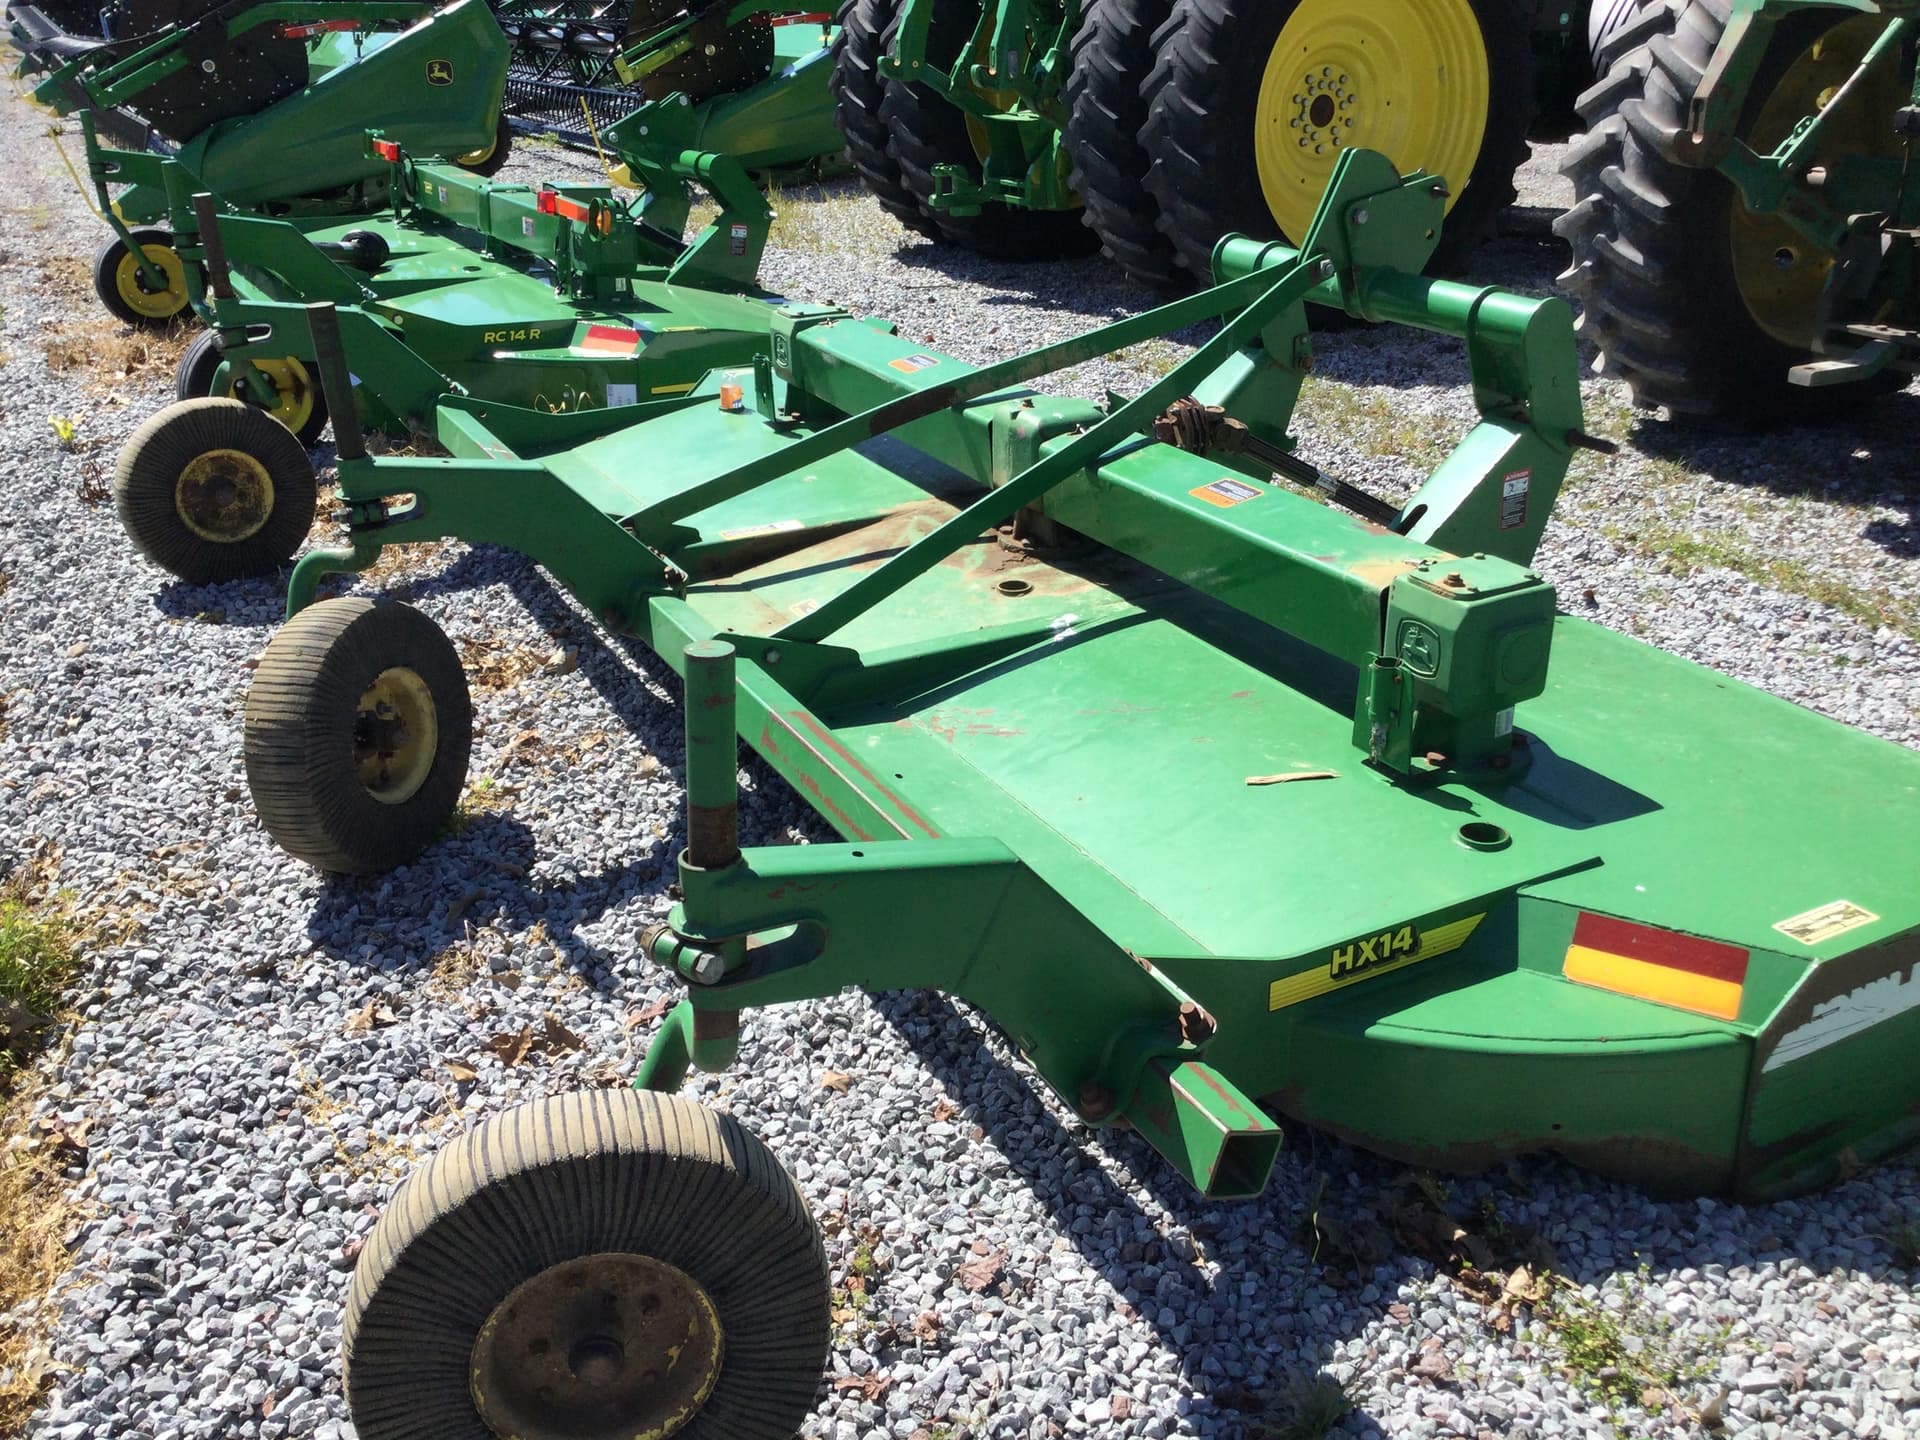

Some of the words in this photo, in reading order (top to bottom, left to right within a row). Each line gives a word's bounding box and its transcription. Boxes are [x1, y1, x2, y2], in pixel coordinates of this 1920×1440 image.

[484, 331, 506, 343] RC
[510, 329, 526, 341] 14
[529, 328, 541, 340] R
[1331, 925, 1414, 976] HX14
